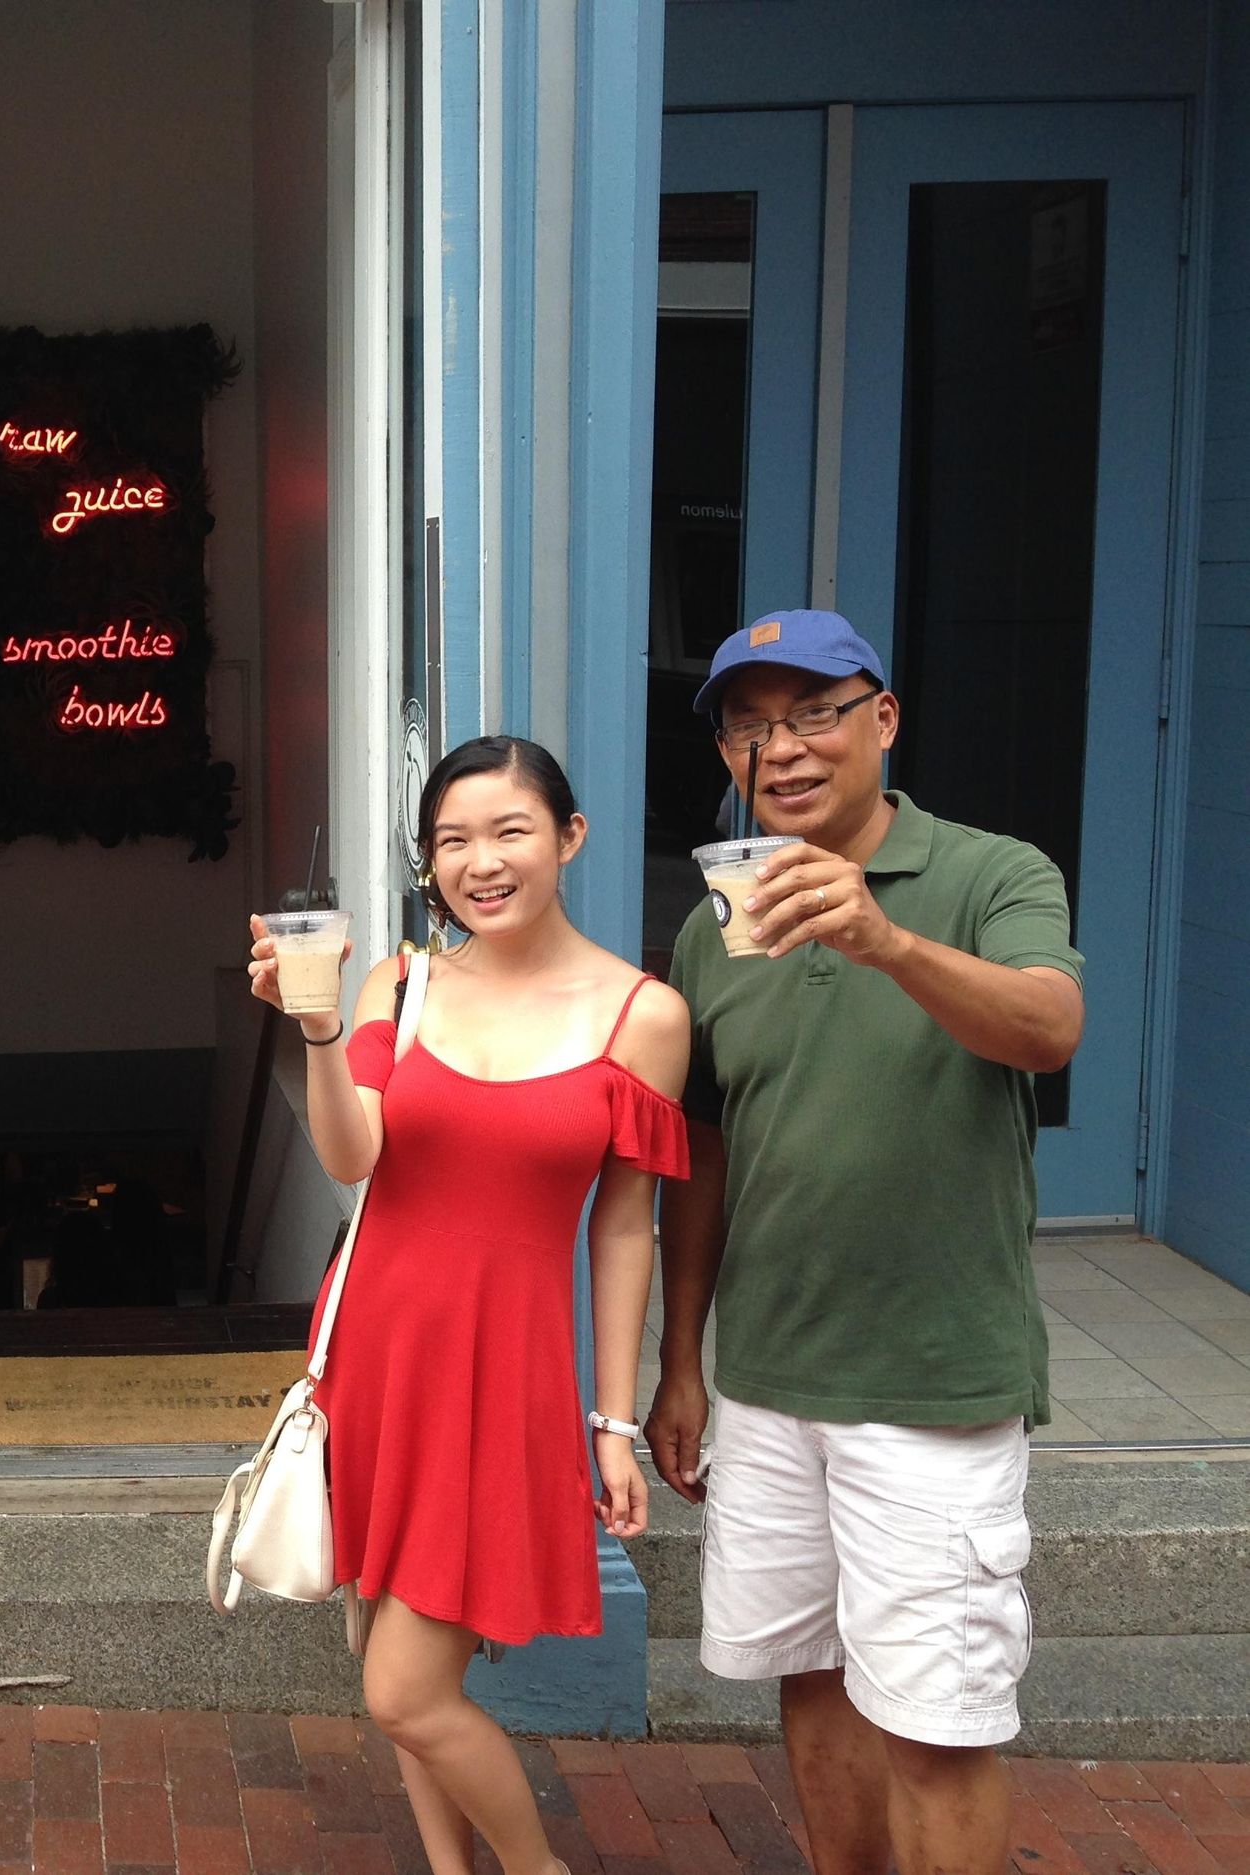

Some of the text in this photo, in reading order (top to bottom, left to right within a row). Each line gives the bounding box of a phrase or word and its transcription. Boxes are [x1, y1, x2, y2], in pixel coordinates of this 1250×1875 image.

[0, 422, 77, 453] raw
[52, 478, 165, 533] juice
[3, 619, 173, 662] smoothie
[61, 685, 165, 726] bowls
